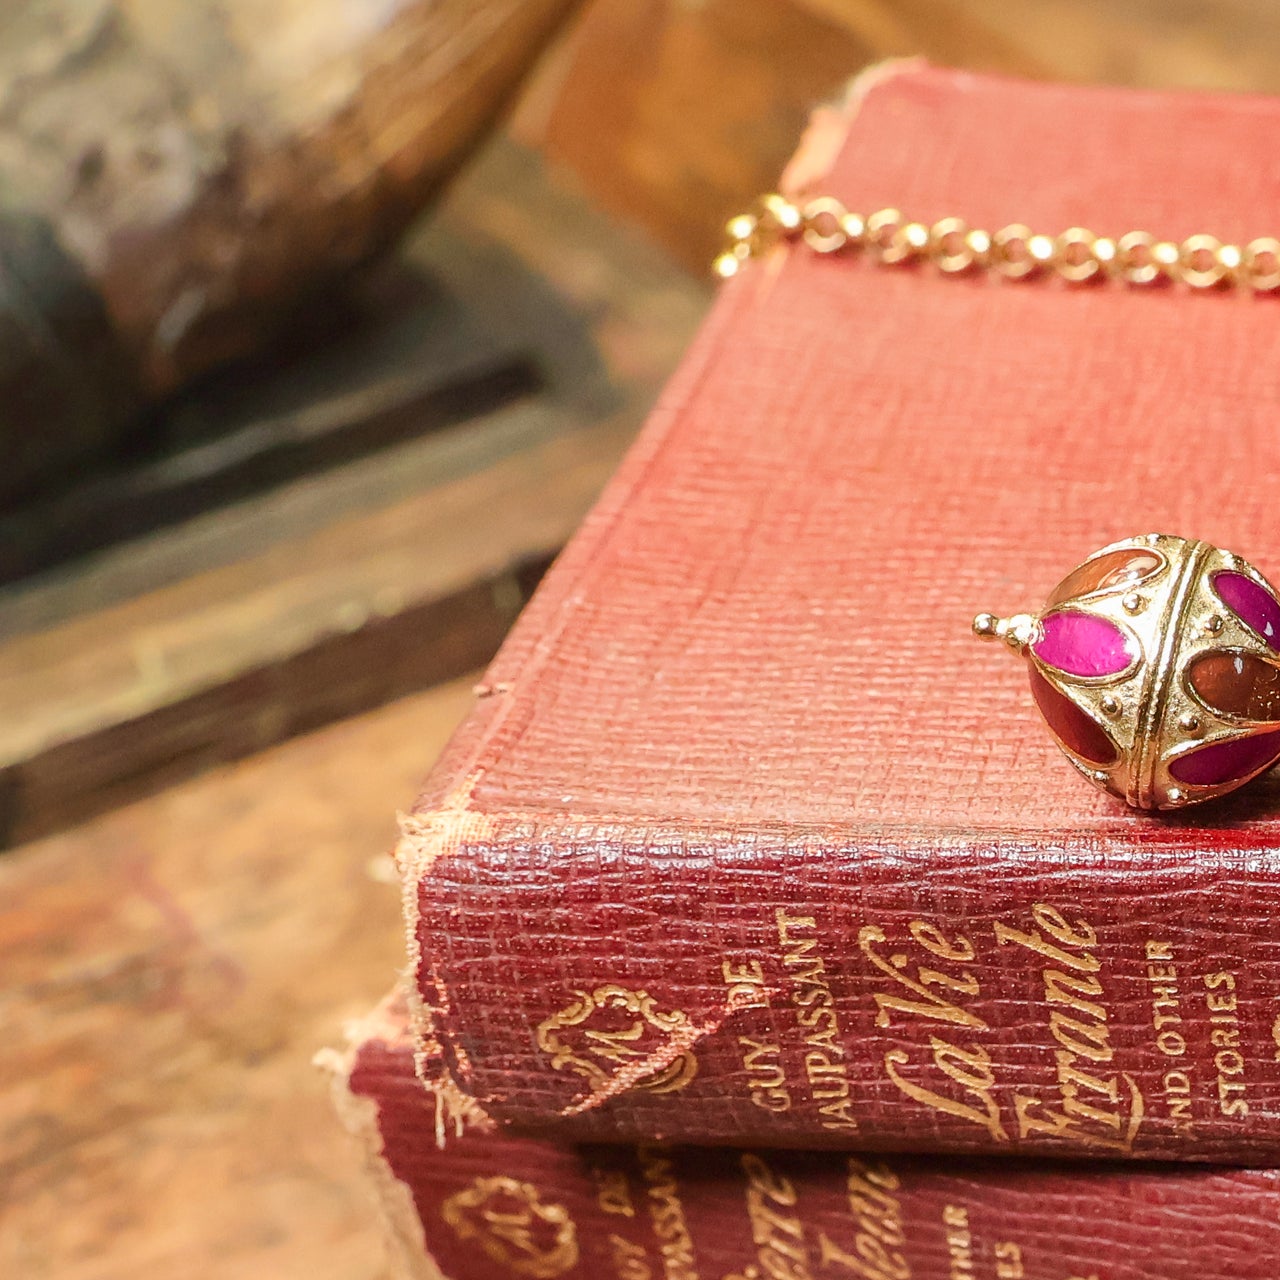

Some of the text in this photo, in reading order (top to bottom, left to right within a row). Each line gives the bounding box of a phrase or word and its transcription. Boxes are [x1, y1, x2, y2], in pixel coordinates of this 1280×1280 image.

[721, 959, 790, 1113] GUY DE
[775, 908, 858, 1130] AUPASSANT
[858, 922, 1010, 1141] La Vie
[993, 903, 1144, 1150] Errante
[1145, 941, 1187, 1056] OTHER
[1204, 971, 1249, 1116] STORIES
